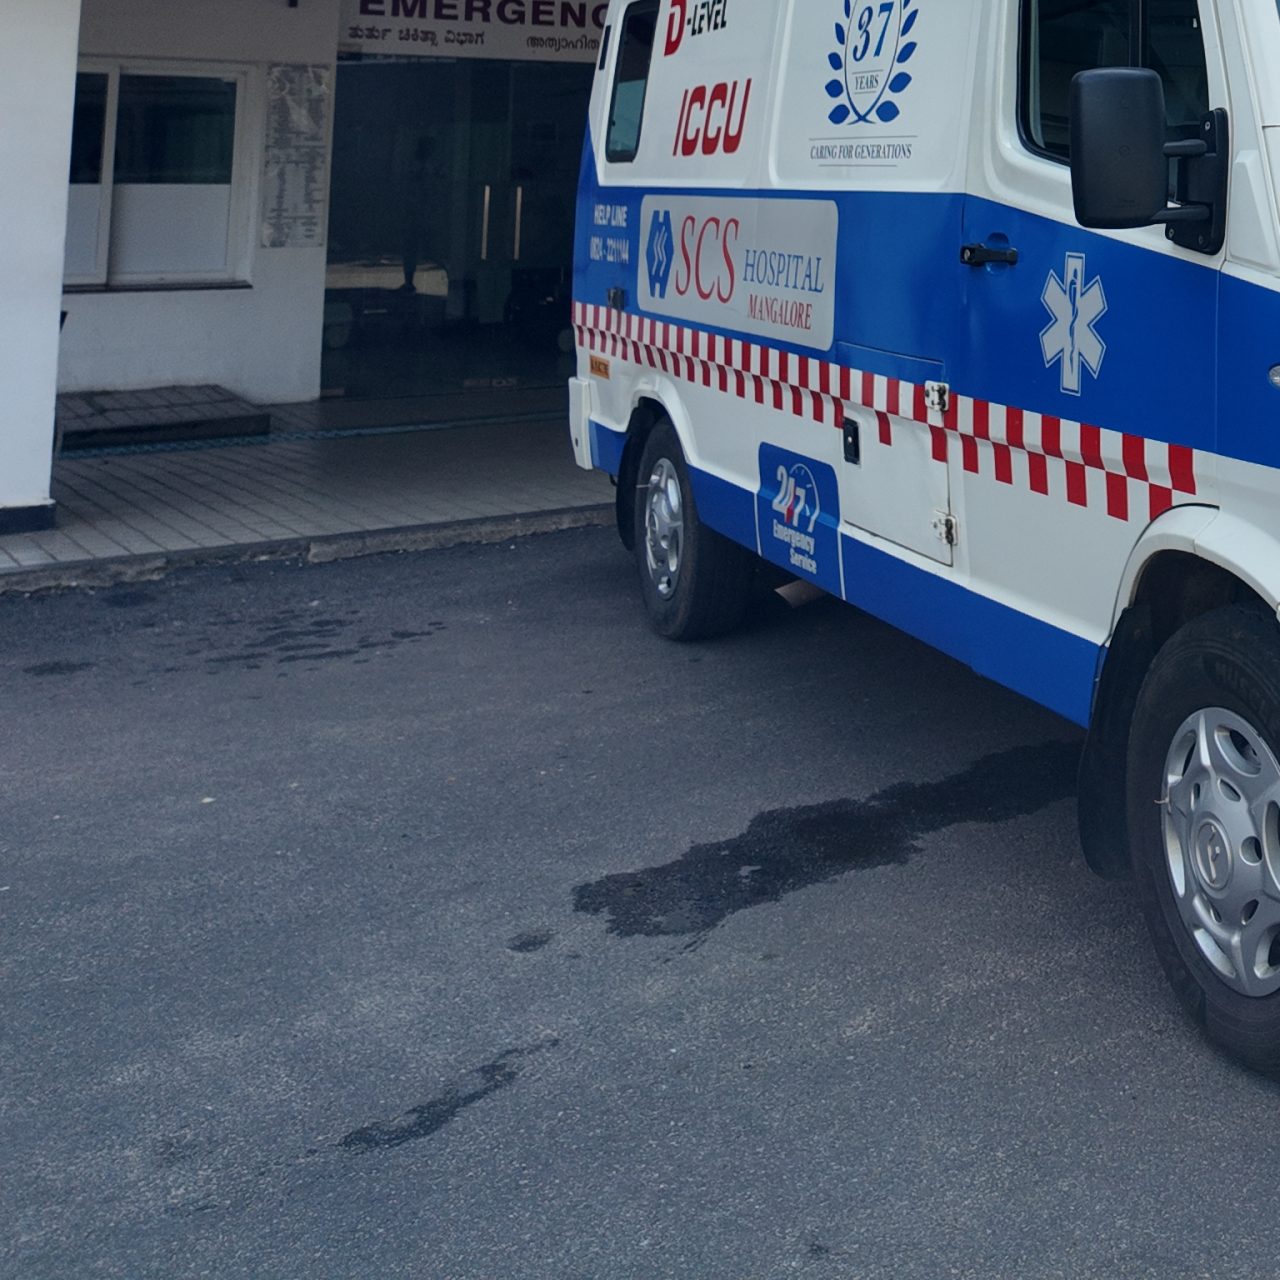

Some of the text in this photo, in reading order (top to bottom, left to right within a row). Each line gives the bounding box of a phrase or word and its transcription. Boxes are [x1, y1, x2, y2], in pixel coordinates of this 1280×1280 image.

[853, 1, 894, 62] 37
[855, 74, 880, 91] YEARS
[672, 78, 752, 157] ICCU
[810, 143, 912, 160] CARING FOR GENERATIONS
[594, 204, 628, 227] HELP LINE
[675, 215, 825, 304] SCS HOSPITAL
[747, 293, 813, 330] MANGALORE
